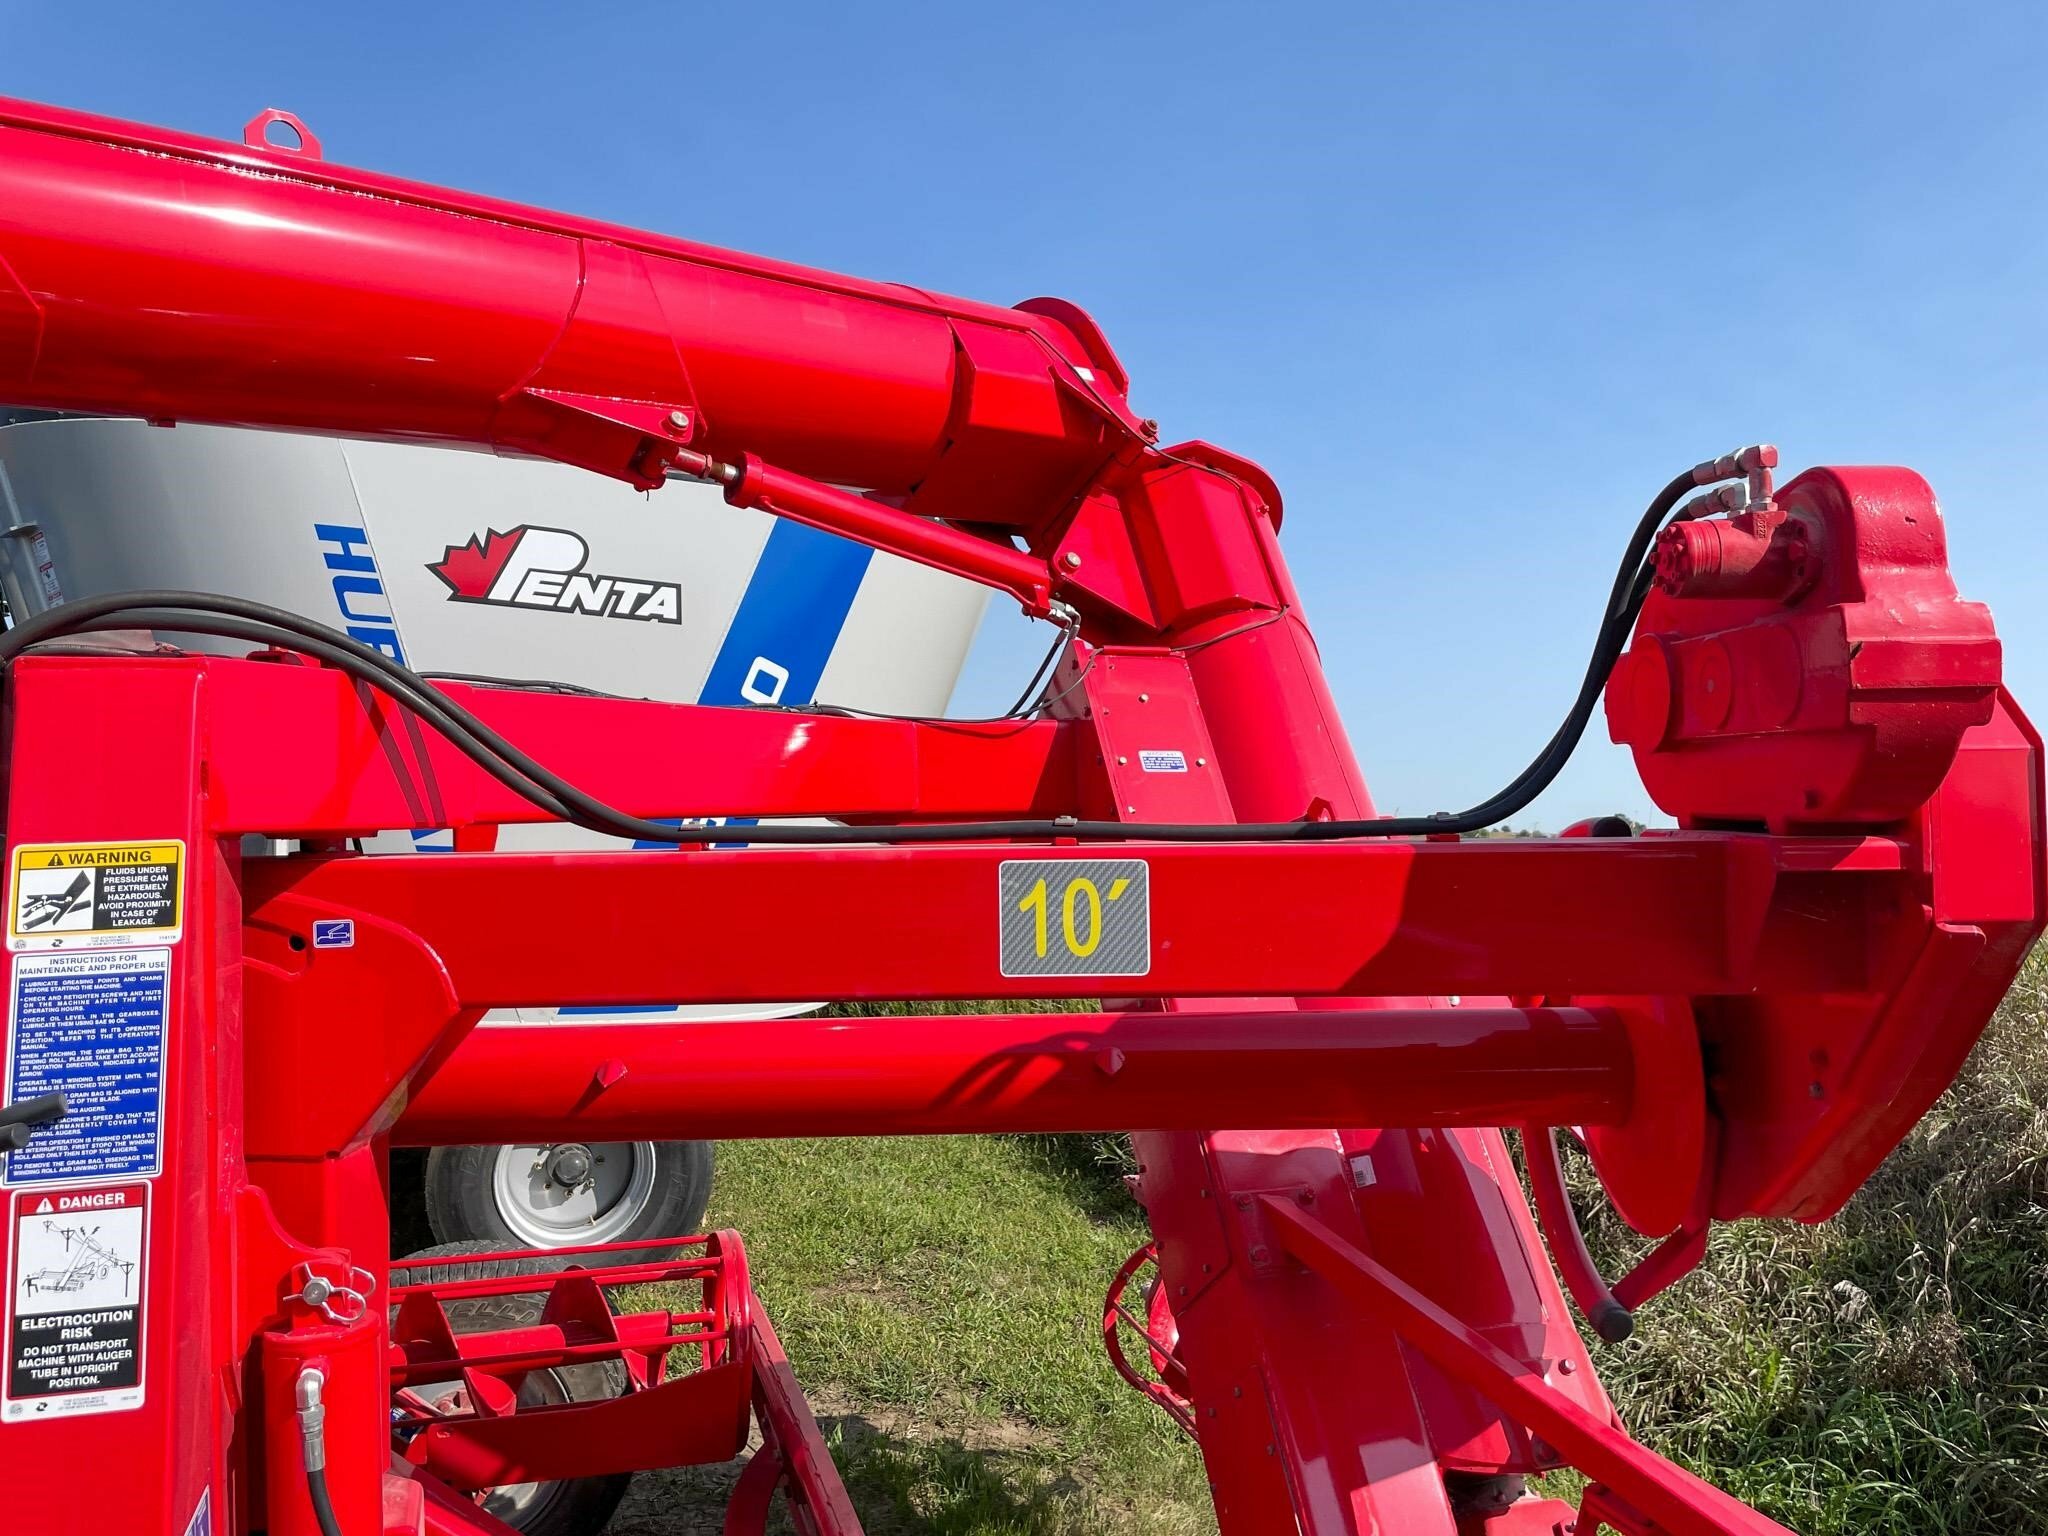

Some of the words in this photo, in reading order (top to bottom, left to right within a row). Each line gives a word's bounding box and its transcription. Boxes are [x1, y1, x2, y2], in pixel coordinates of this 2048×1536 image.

[484, 524, 682, 625] PENTA
[69, 851, 151, 864] WARNING
[106, 867, 135, 875] FLUIDS
[138, 866, 166, 874] UNDER
[118, 883, 167, 892] EXTREMELY
[99, 902, 124, 910] AVOID
[126, 900, 171, 909] PROXIMITY
[50, 956, 116, 965] INSTRUCTIONS
[20, 966, 85, 975] MAINTENANCE
[110, 962, 146, 970] PROPER
[60, 1193, 125, 1209] DANGER
[22, 1310, 133, 1329] ELECTROCUTION
[62, 1327, 93, 1339] RISK
[24, 1347, 39, 1356] DO
[42, 1344, 63, 1354] NOT
[65, 1339, 128, 1353] TRANSPORT
[18, 1357, 66, 1368] MACHINE
[68, 1354, 93, 1364] WITH
[96, 1350, 132, 1361] AUGER
[31, 1369, 58, 1378] TUBE
[62, 1367, 72, 1376] IN
[74, 1363, 119, 1375] UPRIGHT
[49, 1376, 99, 1388] POSITION.
